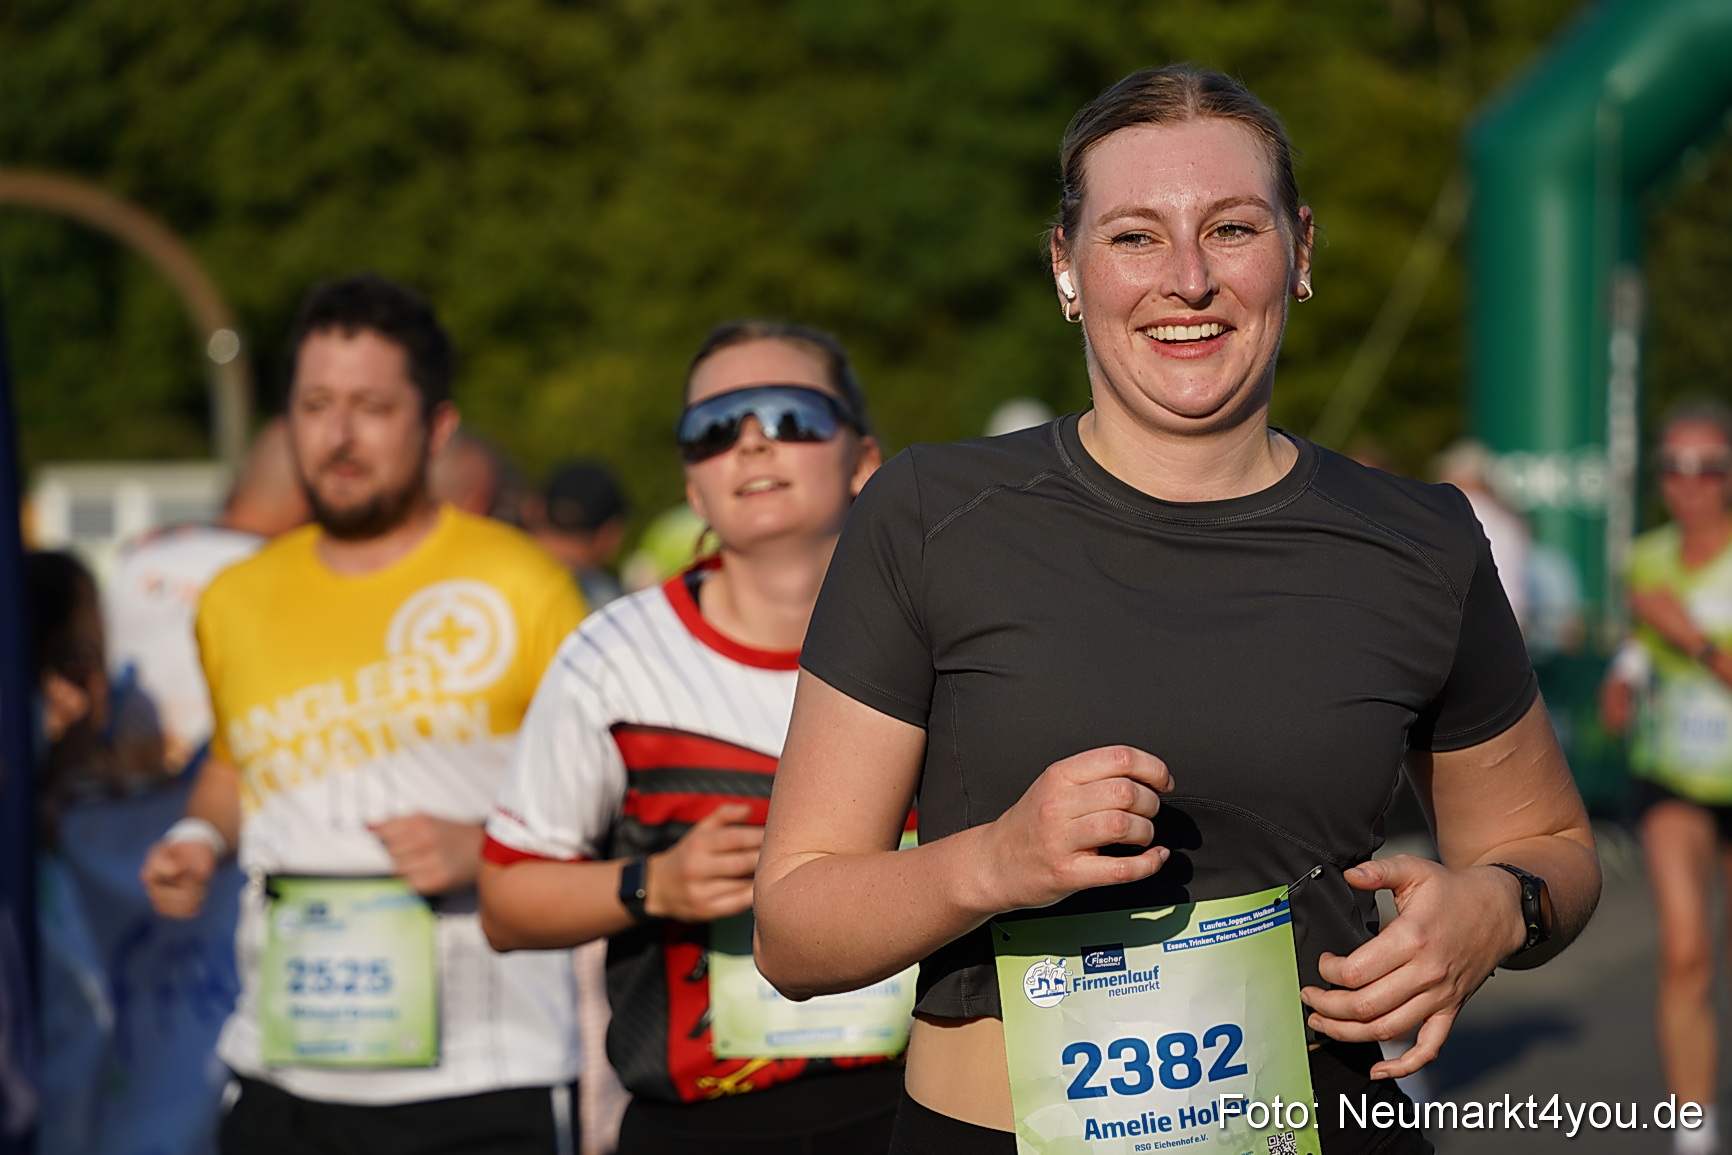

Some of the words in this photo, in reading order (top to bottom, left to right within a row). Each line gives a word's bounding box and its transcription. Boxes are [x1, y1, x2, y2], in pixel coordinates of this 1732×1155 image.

[1203, 920, 1228, 931] Laufen,
[1228, 914, 1252, 926] Joggen,
[1252, 907, 1275, 919] Walken
[1166, 941, 1189, 951] Essen,
[1189, 936, 1216, 947] Trinken,
[1216, 931, 1238, 942] Feiern,
[1238, 920, 1274, 936] Netzwerken
[1091, 953, 1122, 965] Fischer
[287, 958, 393, 996] 2525
[1073, 965, 1160, 992] Firmenlauf
[1108, 981, 1160, 998] neumarkt
[1061, 1023, 1248, 1101] 2382
[1084, 1111, 1173, 1141] Amelie
[1178, 1098, 1250, 1129] Holer
[1134, 1143, 1152, 1152] RSG
[1154, 1136, 1194, 1150] Eichenhof
